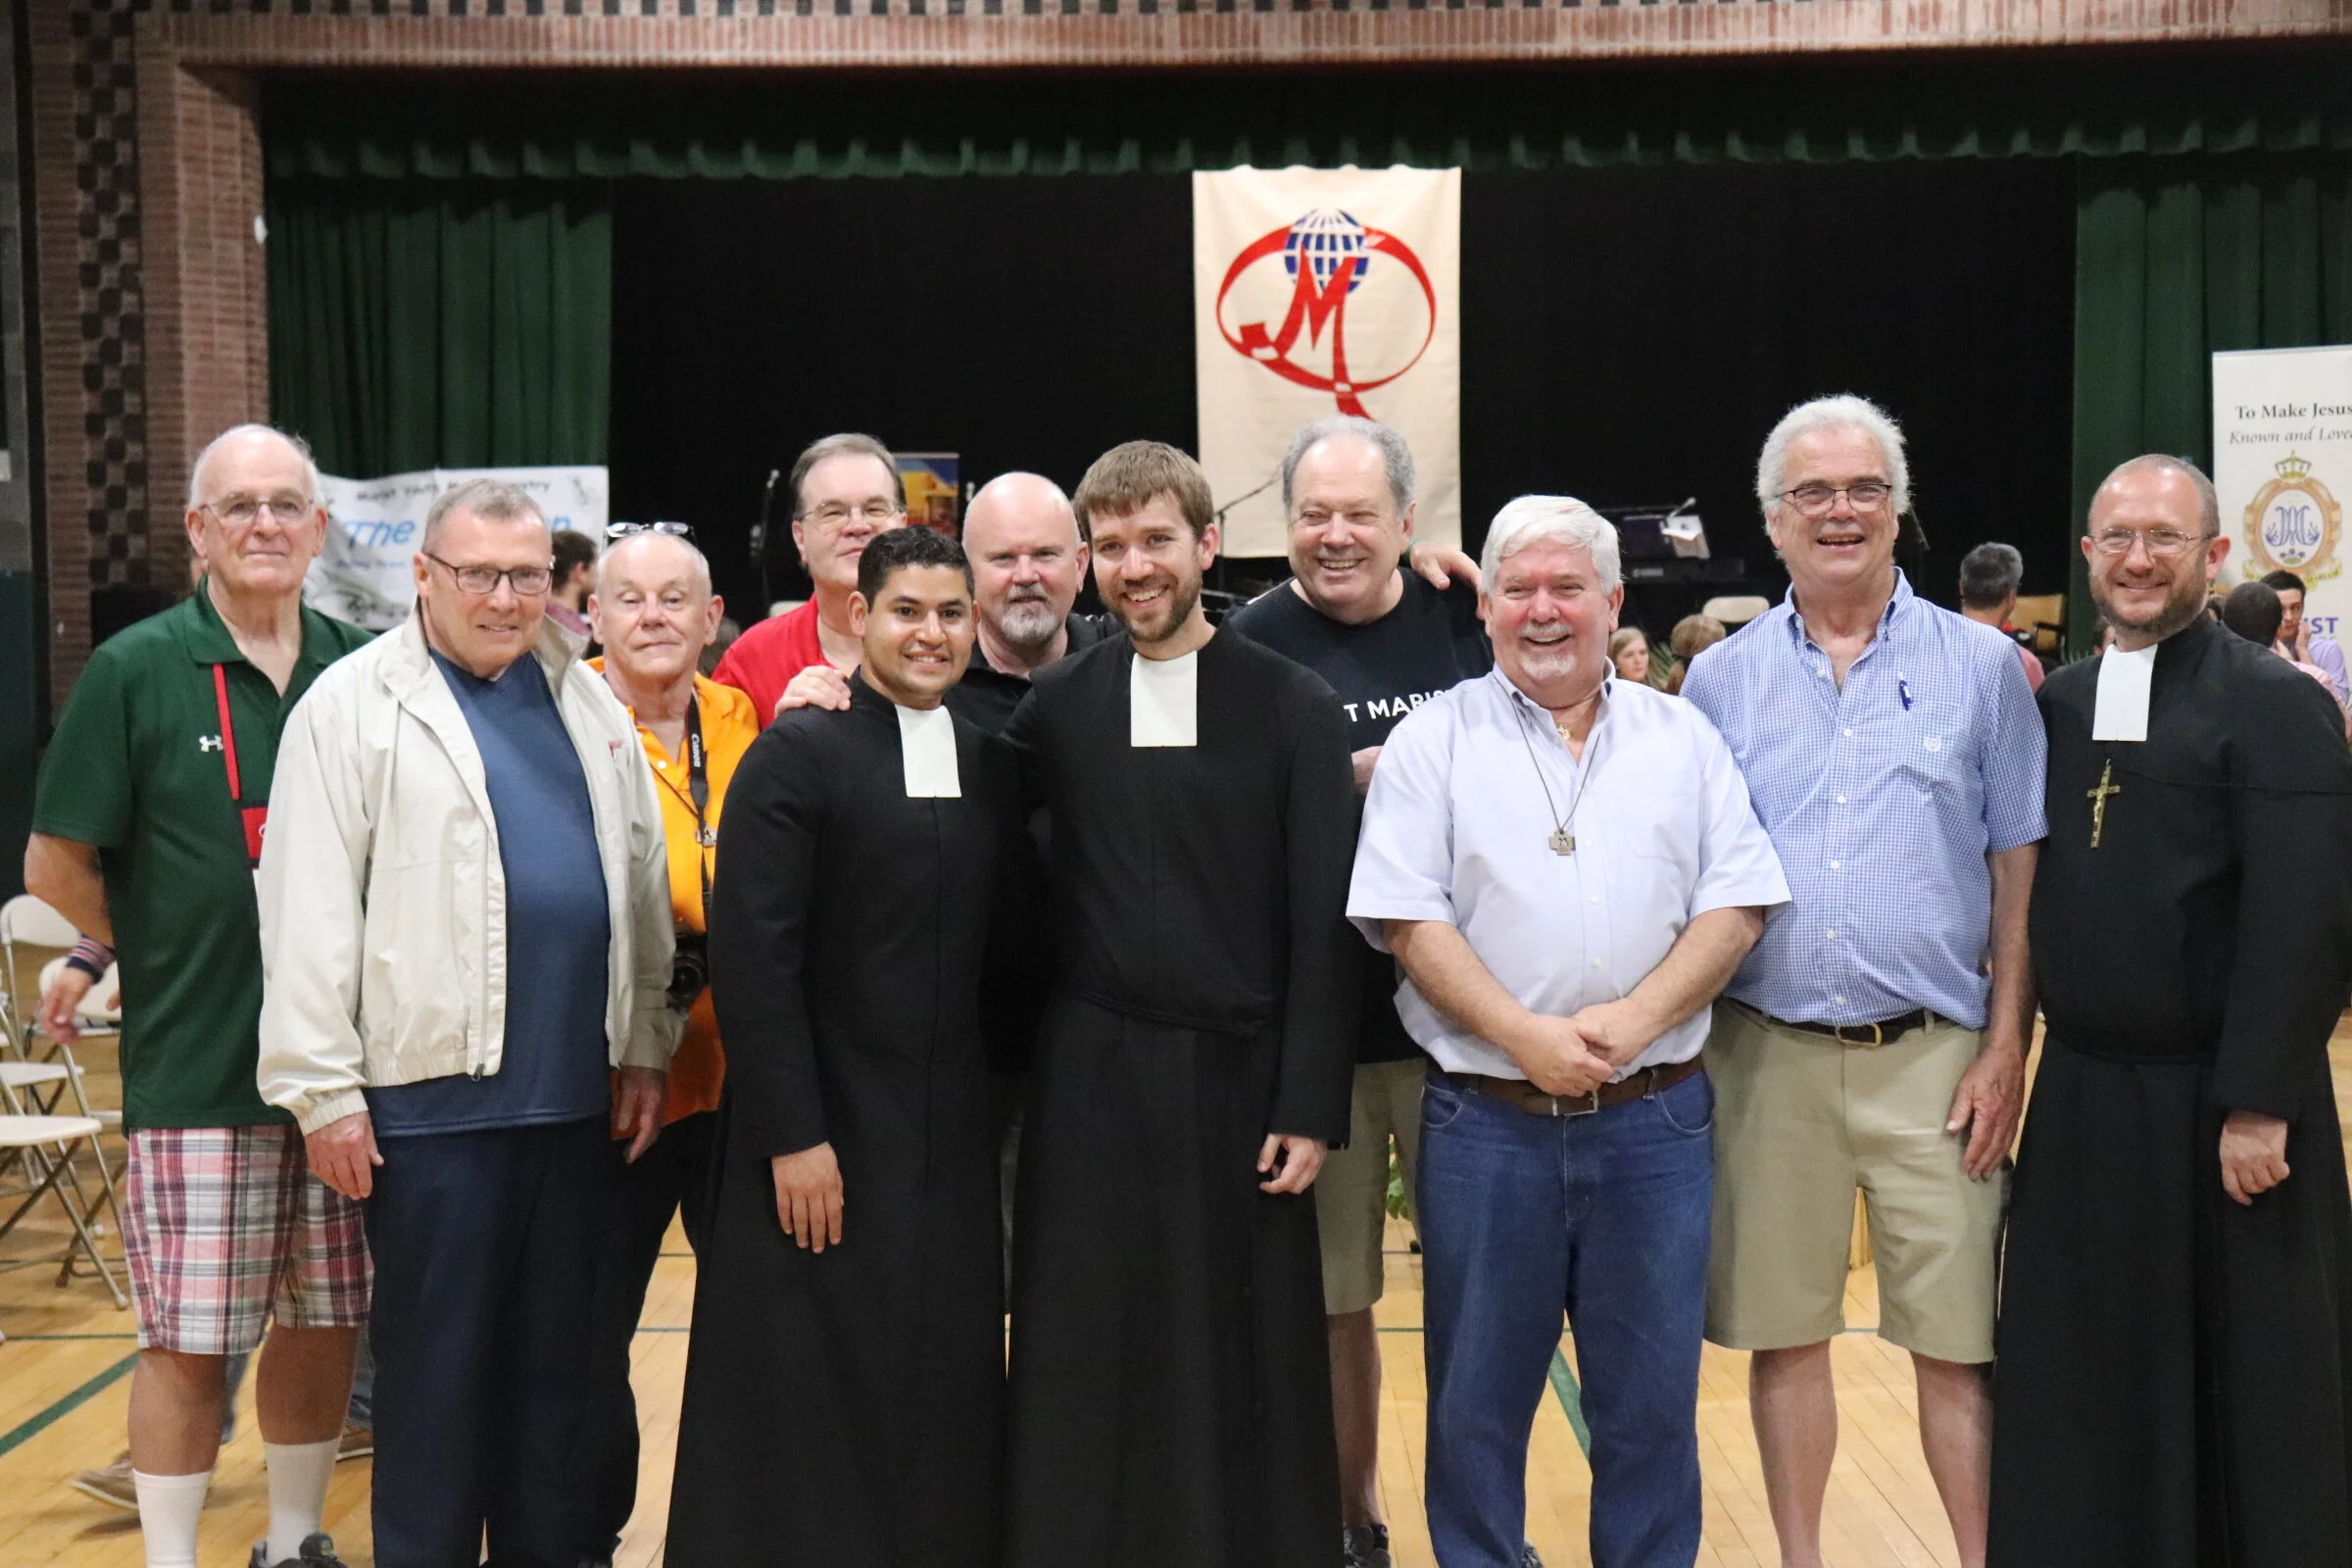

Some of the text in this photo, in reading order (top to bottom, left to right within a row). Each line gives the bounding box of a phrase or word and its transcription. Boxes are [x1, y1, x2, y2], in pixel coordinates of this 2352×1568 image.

[2235, 402, 2352, 419] To Make Jesus
[2230, 431, 2279, 444] Known
[2284, 425, 2316, 441] and
[344, 519, 416, 551] The
[2303, 616, 2339, 634] ST
[1344, 703, 1358, 722] T
